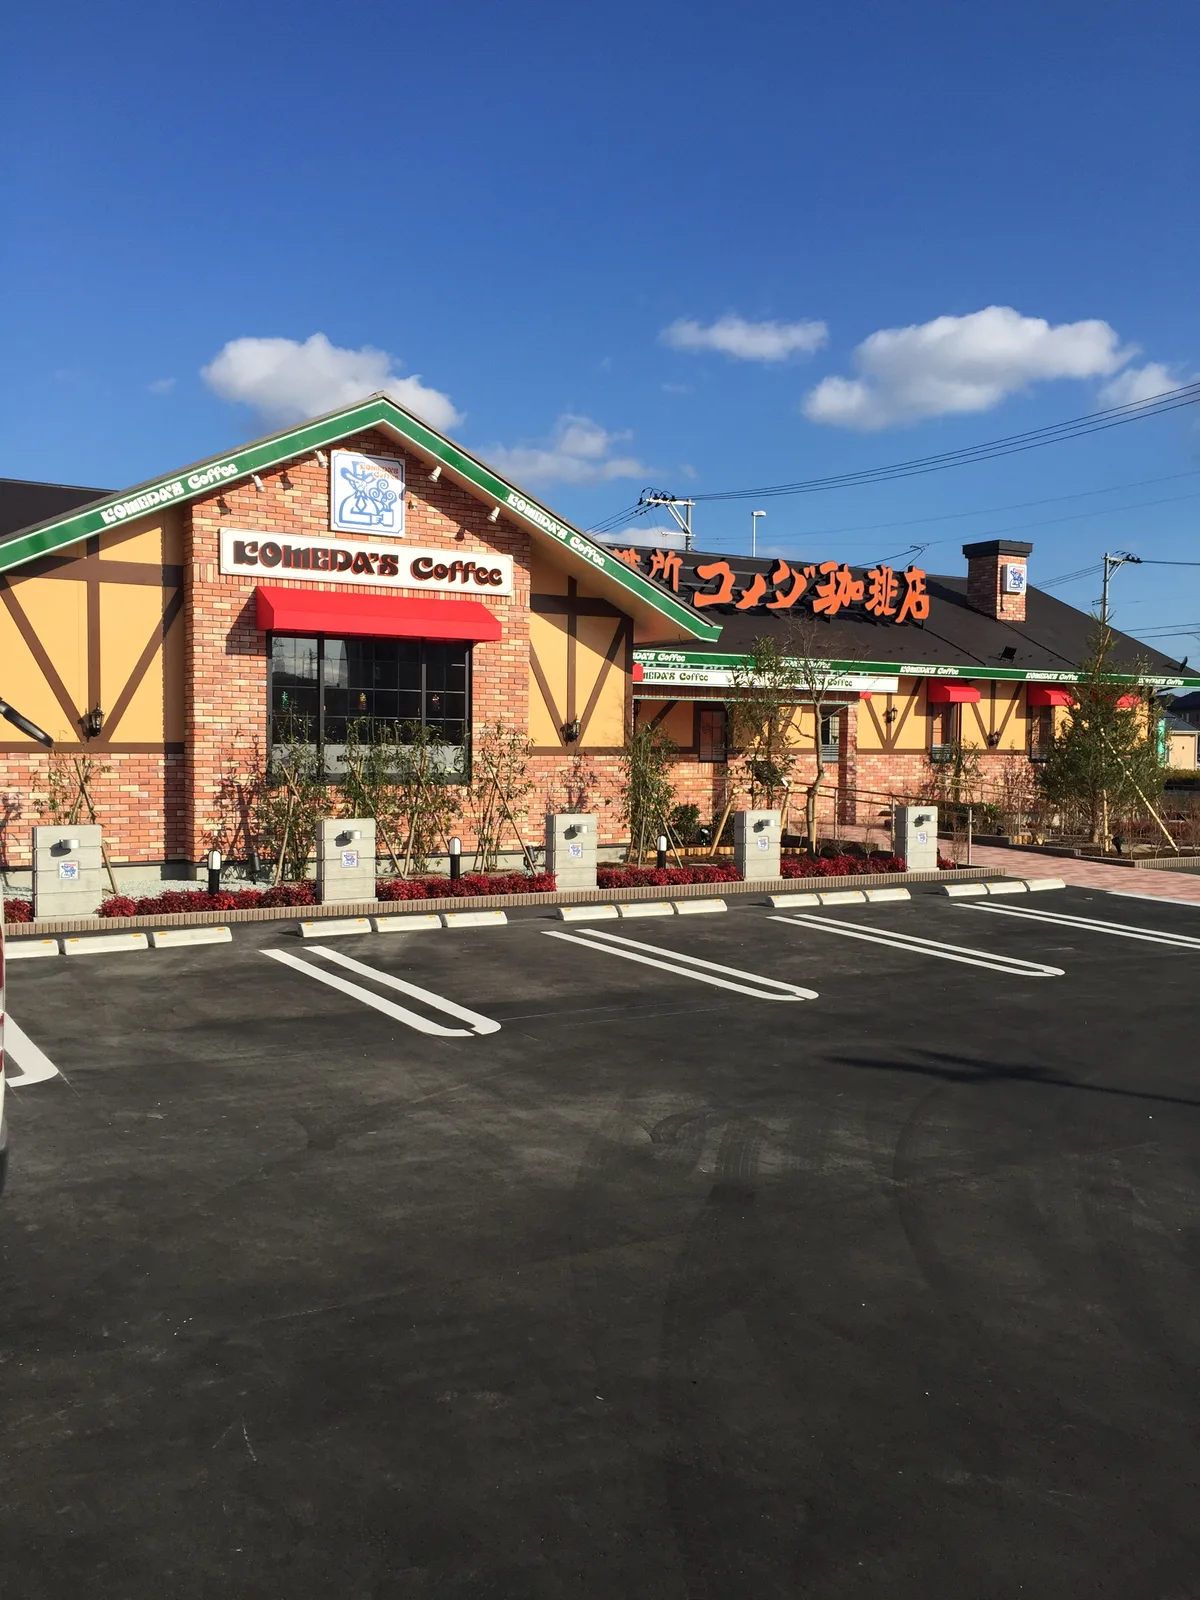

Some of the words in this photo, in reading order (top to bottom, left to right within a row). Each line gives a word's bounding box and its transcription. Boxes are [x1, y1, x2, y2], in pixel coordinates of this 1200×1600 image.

[101, 482, 184, 524] KOMEDA'S
[188, 463, 238, 489] Coffee
[507, 493, 568, 539] KOMEDA'S
[570, 537, 606, 566] Coffee
[233, 541, 398, 576] KOMEDA'S
[410, 556, 503, 585] Coffee
[658, 654, 686, 662] Coffee
[937, 667, 959, 675] Coffee
[679, 672, 709, 681] Coffee
